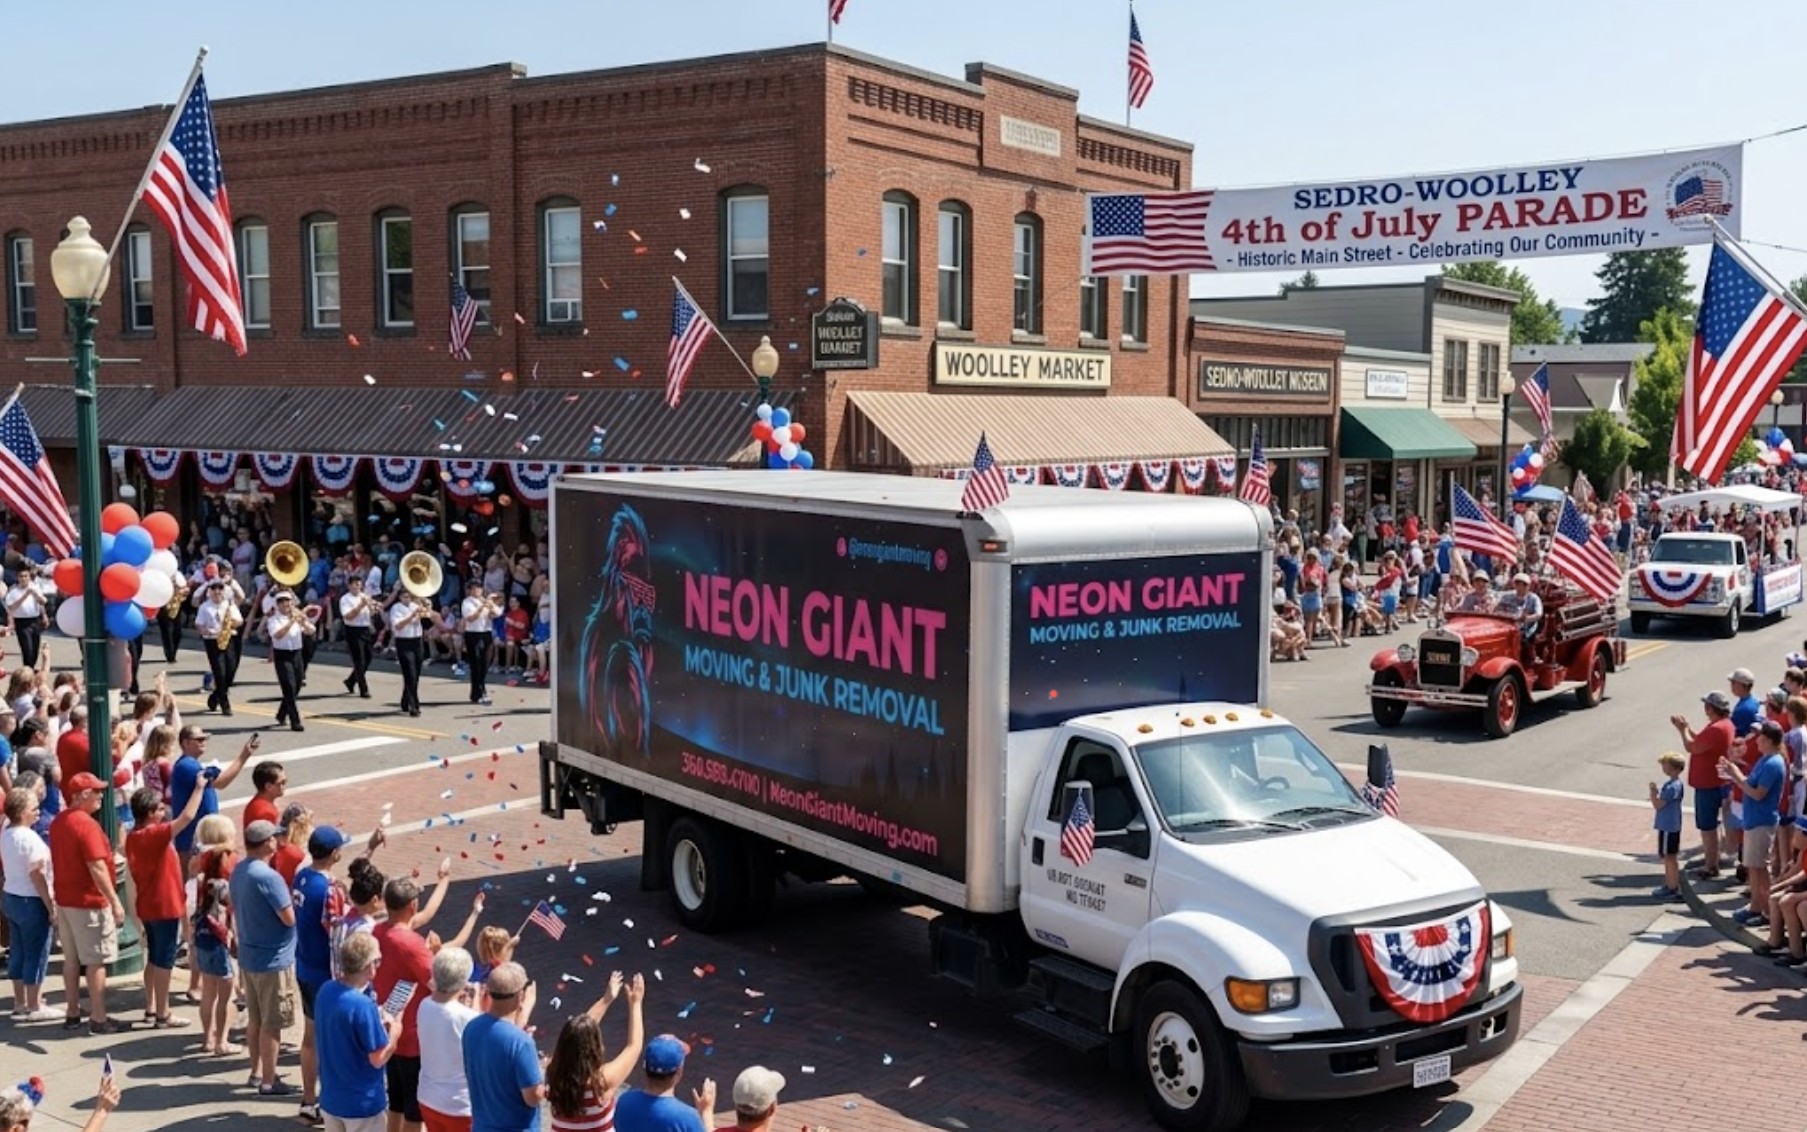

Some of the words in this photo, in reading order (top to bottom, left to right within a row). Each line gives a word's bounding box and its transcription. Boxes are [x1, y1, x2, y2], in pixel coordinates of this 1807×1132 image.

[1294, 166, 1584, 210] SEDRO-WOOLLEY
[1221, 216, 1287, 245] 4th
[1301, 211, 1342, 242] of
[1352, 206, 1442, 243] July
[1456, 188, 1648, 232] PARADE
[1237, 250, 1297, 268] Historic
[1301, 248, 1339, 265] Main
[1344, 245, 1392, 262] Street
[1409, 239, 1504, 260] Celebrating
[1510, 236, 1540, 253] Our
[1545, 227, 1646, 251] Community
[945, 351, 1032, 379] WOOLLEY
[1038, 356, 1104, 381] MARKET
[1030, 579, 1132, 618] NEON
[1142, 573, 1245, 610] GIANT
[684, 571, 789, 648] NEON
[802, 590, 946, 680] GIANT
[1030, 622, 1100, 644] MOVING
[1103, 620, 1116, 638] &
[1119, 617, 1163, 637] JUNK
[1167, 611, 1242, 632] REMOVAL
[685, 645, 754, 688] MOVING
[759, 661, 771, 692] &
[775, 664, 829, 707] JUNK
[834, 678, 945, 735] REMOVAL
[770, 781, 938, 856] NeonGiantMoving.com
